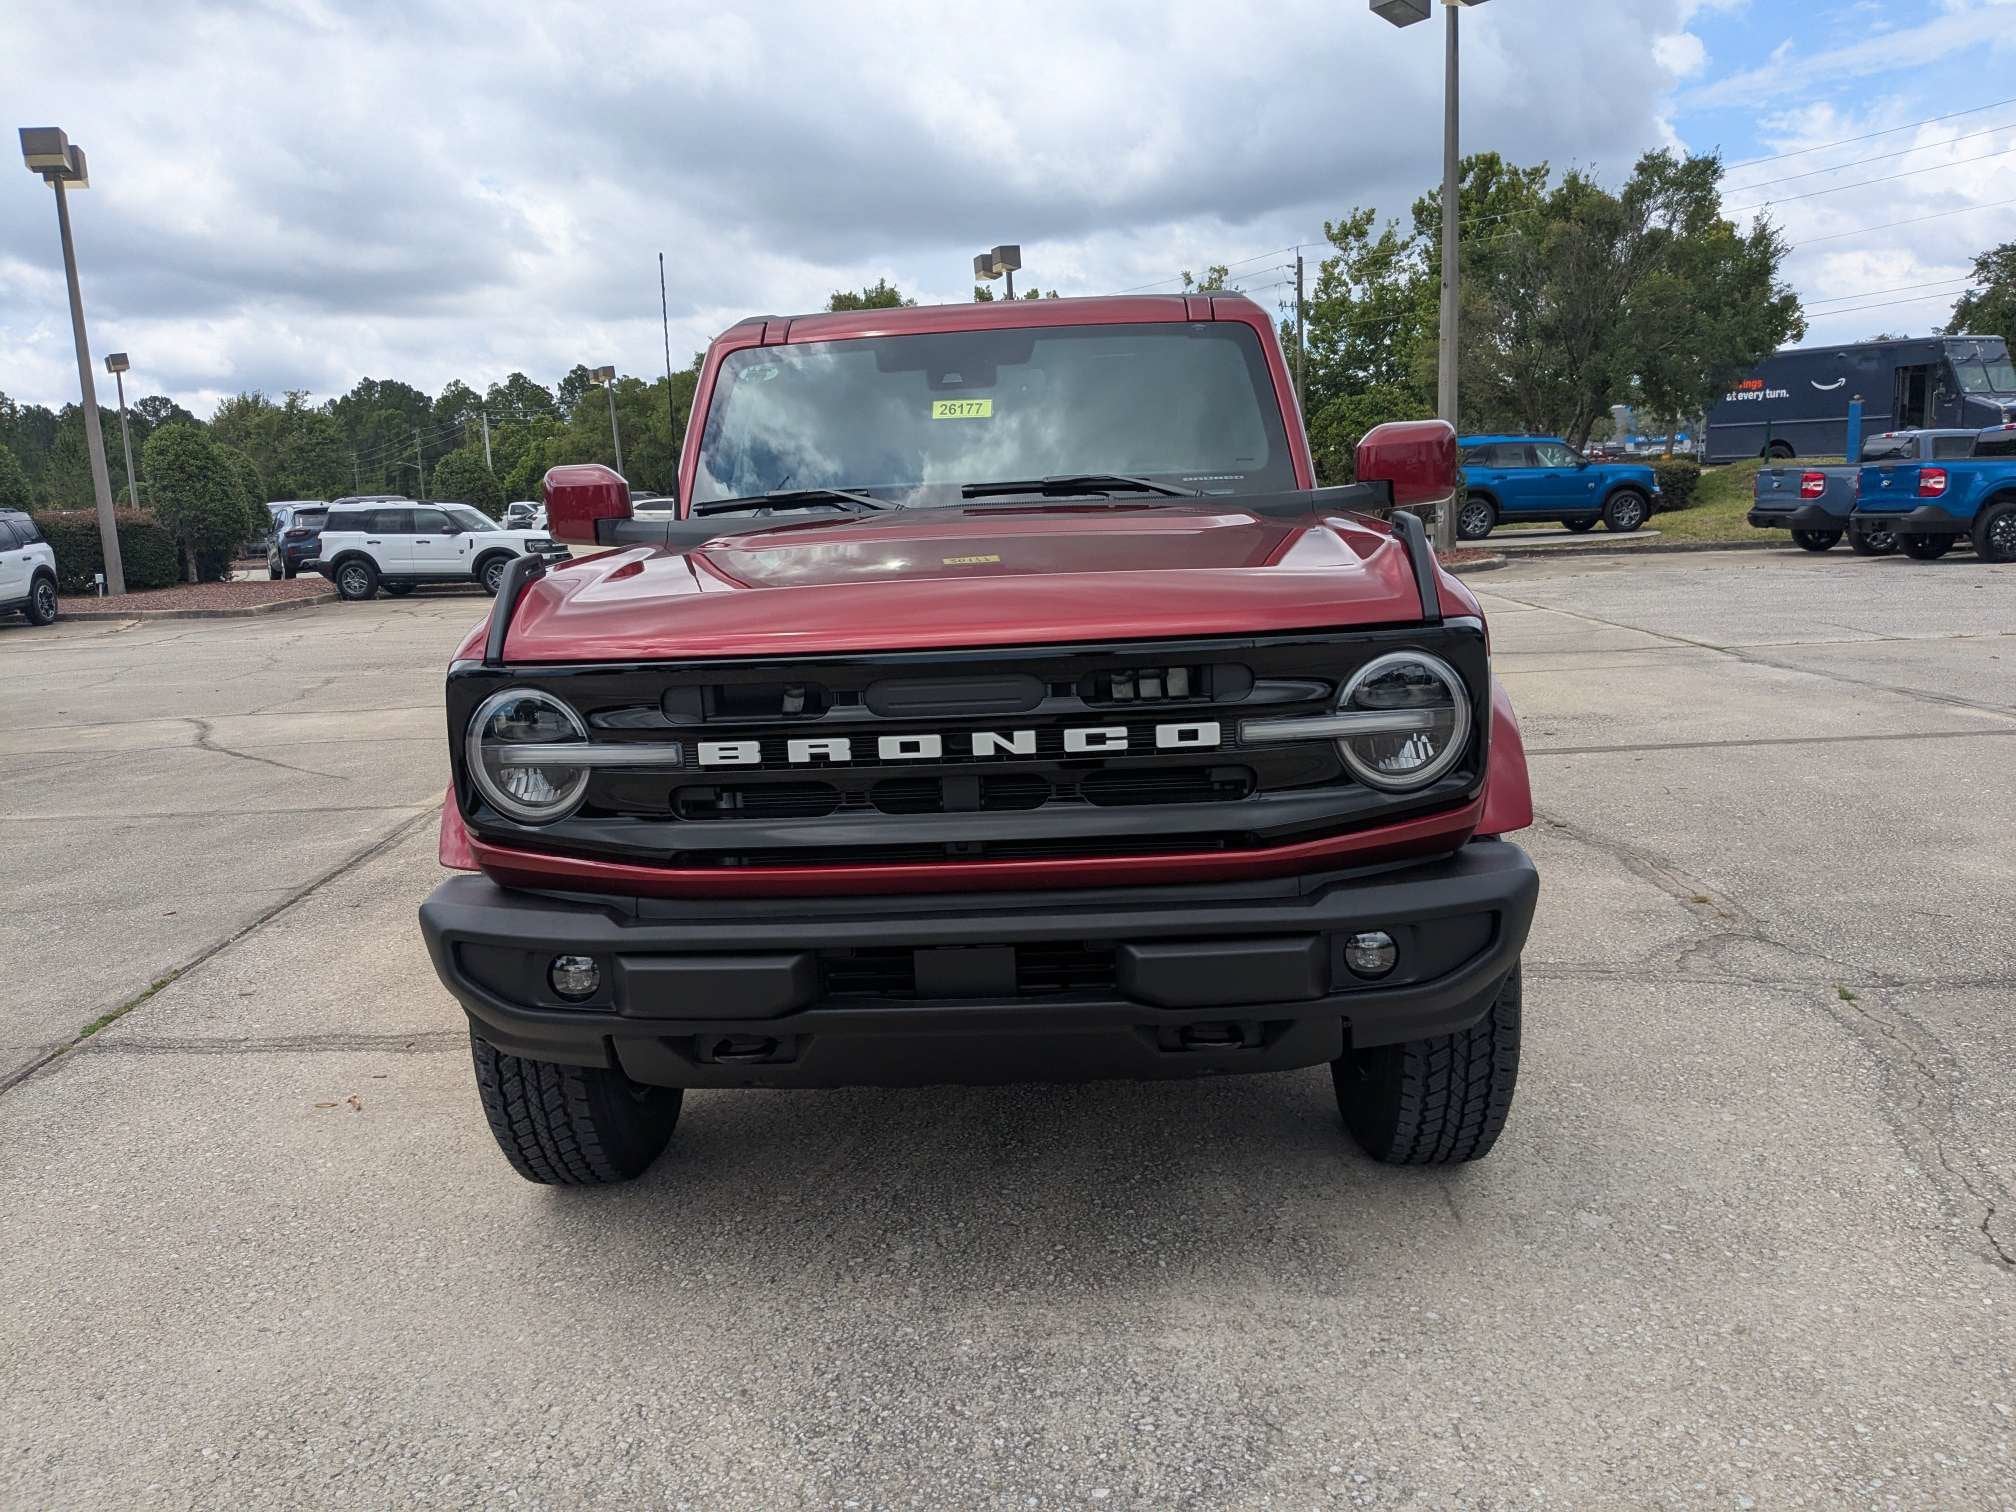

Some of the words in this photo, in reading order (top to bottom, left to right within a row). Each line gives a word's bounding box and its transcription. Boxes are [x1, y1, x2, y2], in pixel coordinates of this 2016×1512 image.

[1737, 390, 1764, 401] every
[1765, 388, 1790, 399] turn.
[939, 402, 983, 416] 26177
[697, 722, 1221, 766] BRONCO
